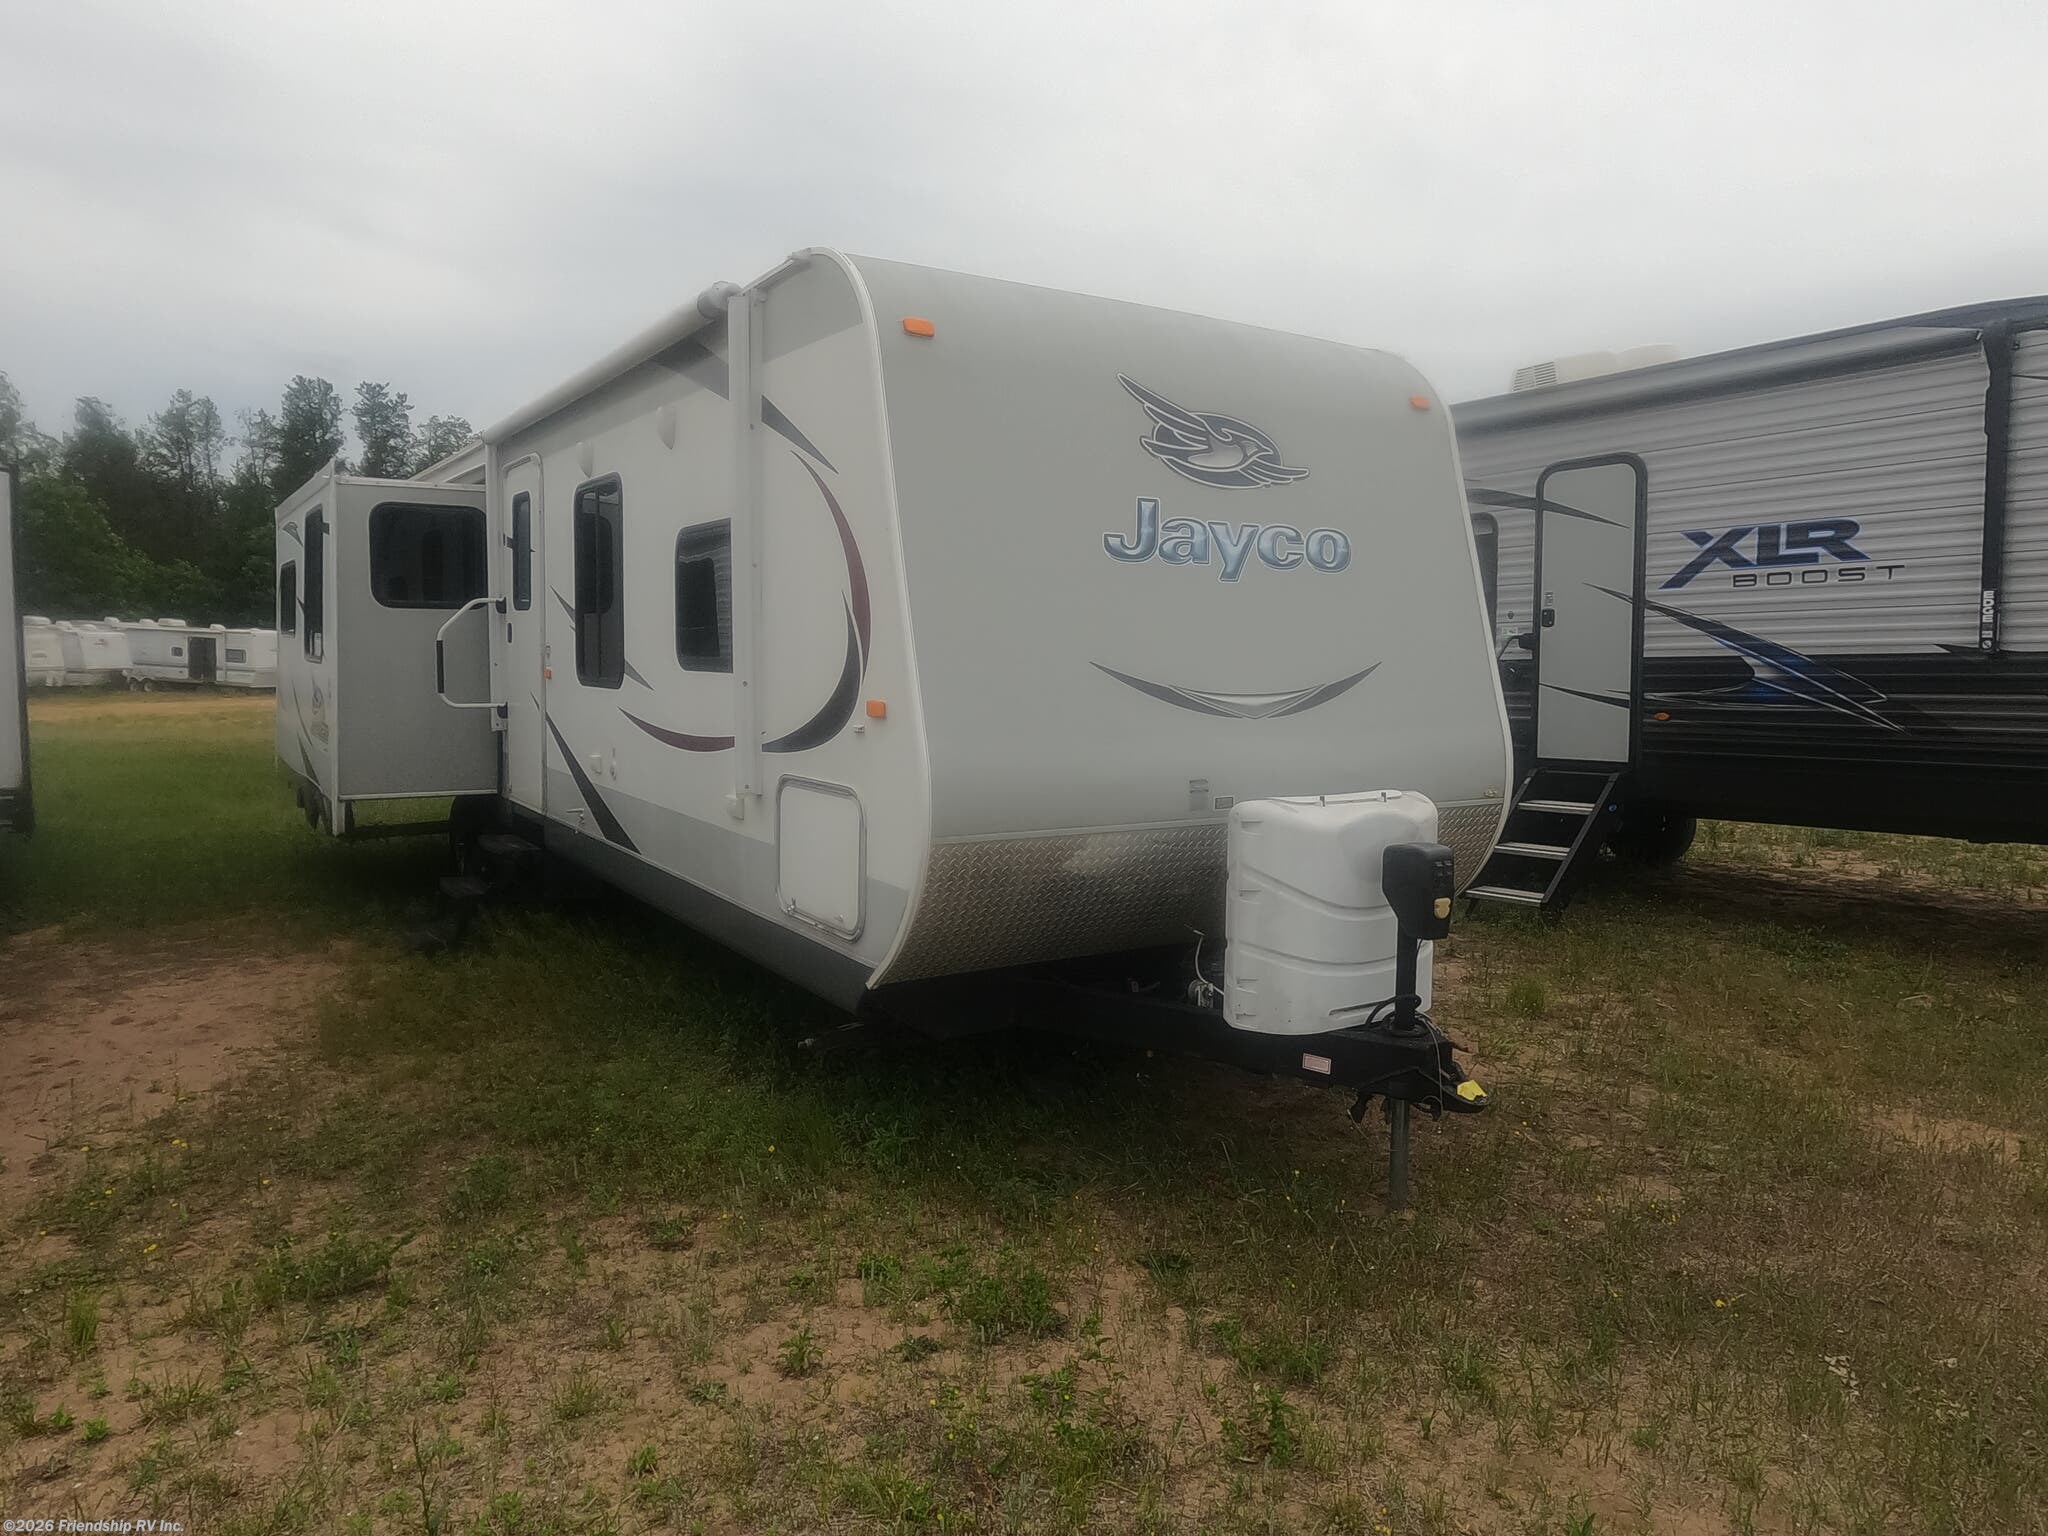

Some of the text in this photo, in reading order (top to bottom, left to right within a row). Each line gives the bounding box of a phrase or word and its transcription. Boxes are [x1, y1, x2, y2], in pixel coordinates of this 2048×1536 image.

[1102, 496, 1352, 583] Jayco
[1658, 518, 1872, 590] XLR
[1732, 564, 1906, 588] BOOST
